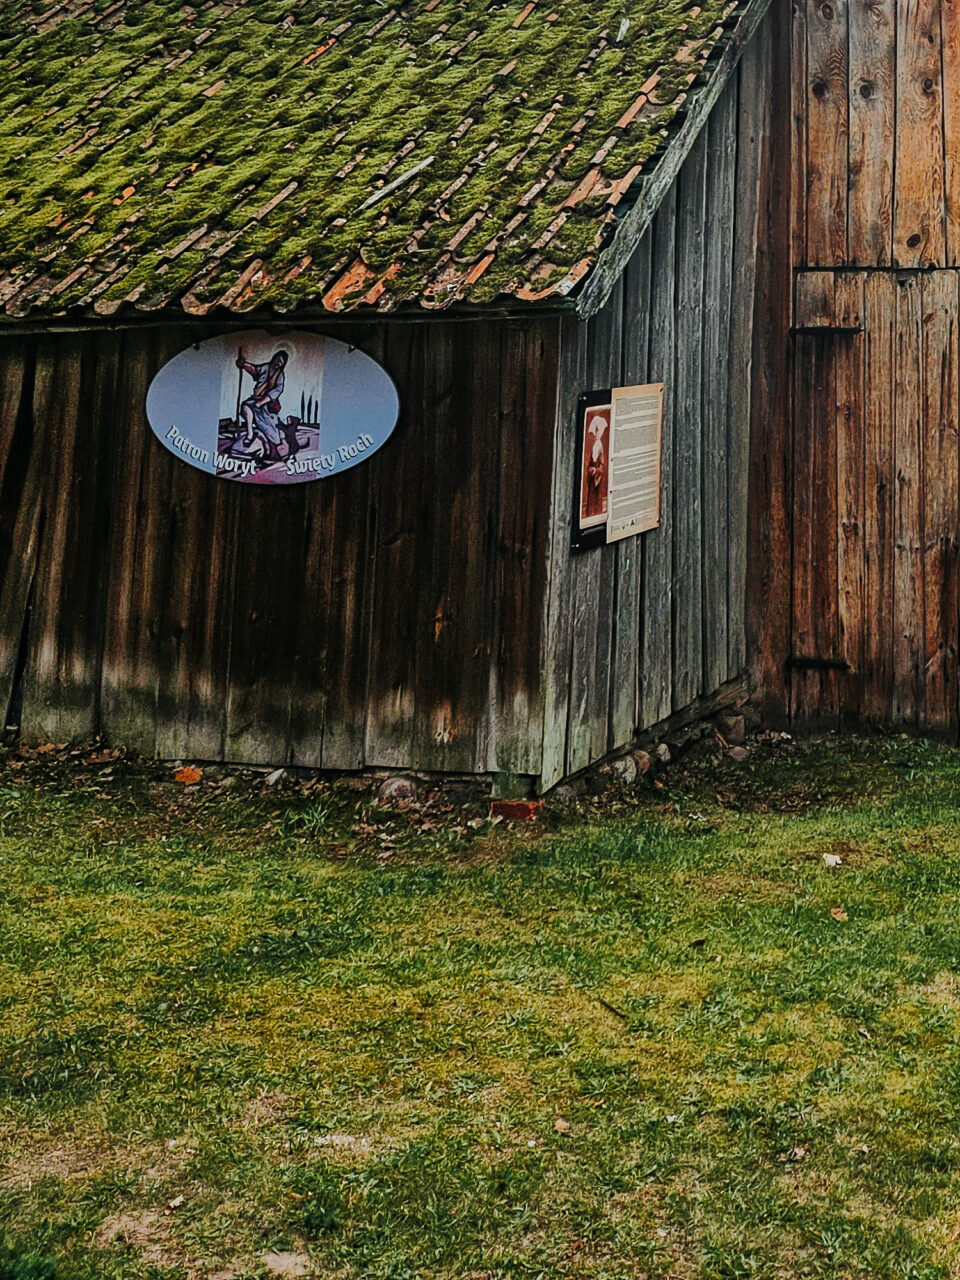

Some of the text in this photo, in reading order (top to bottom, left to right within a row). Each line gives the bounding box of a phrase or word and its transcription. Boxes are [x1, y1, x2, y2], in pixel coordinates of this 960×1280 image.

[165, 425, 374, 477] Patron Woryt Święty Roch
